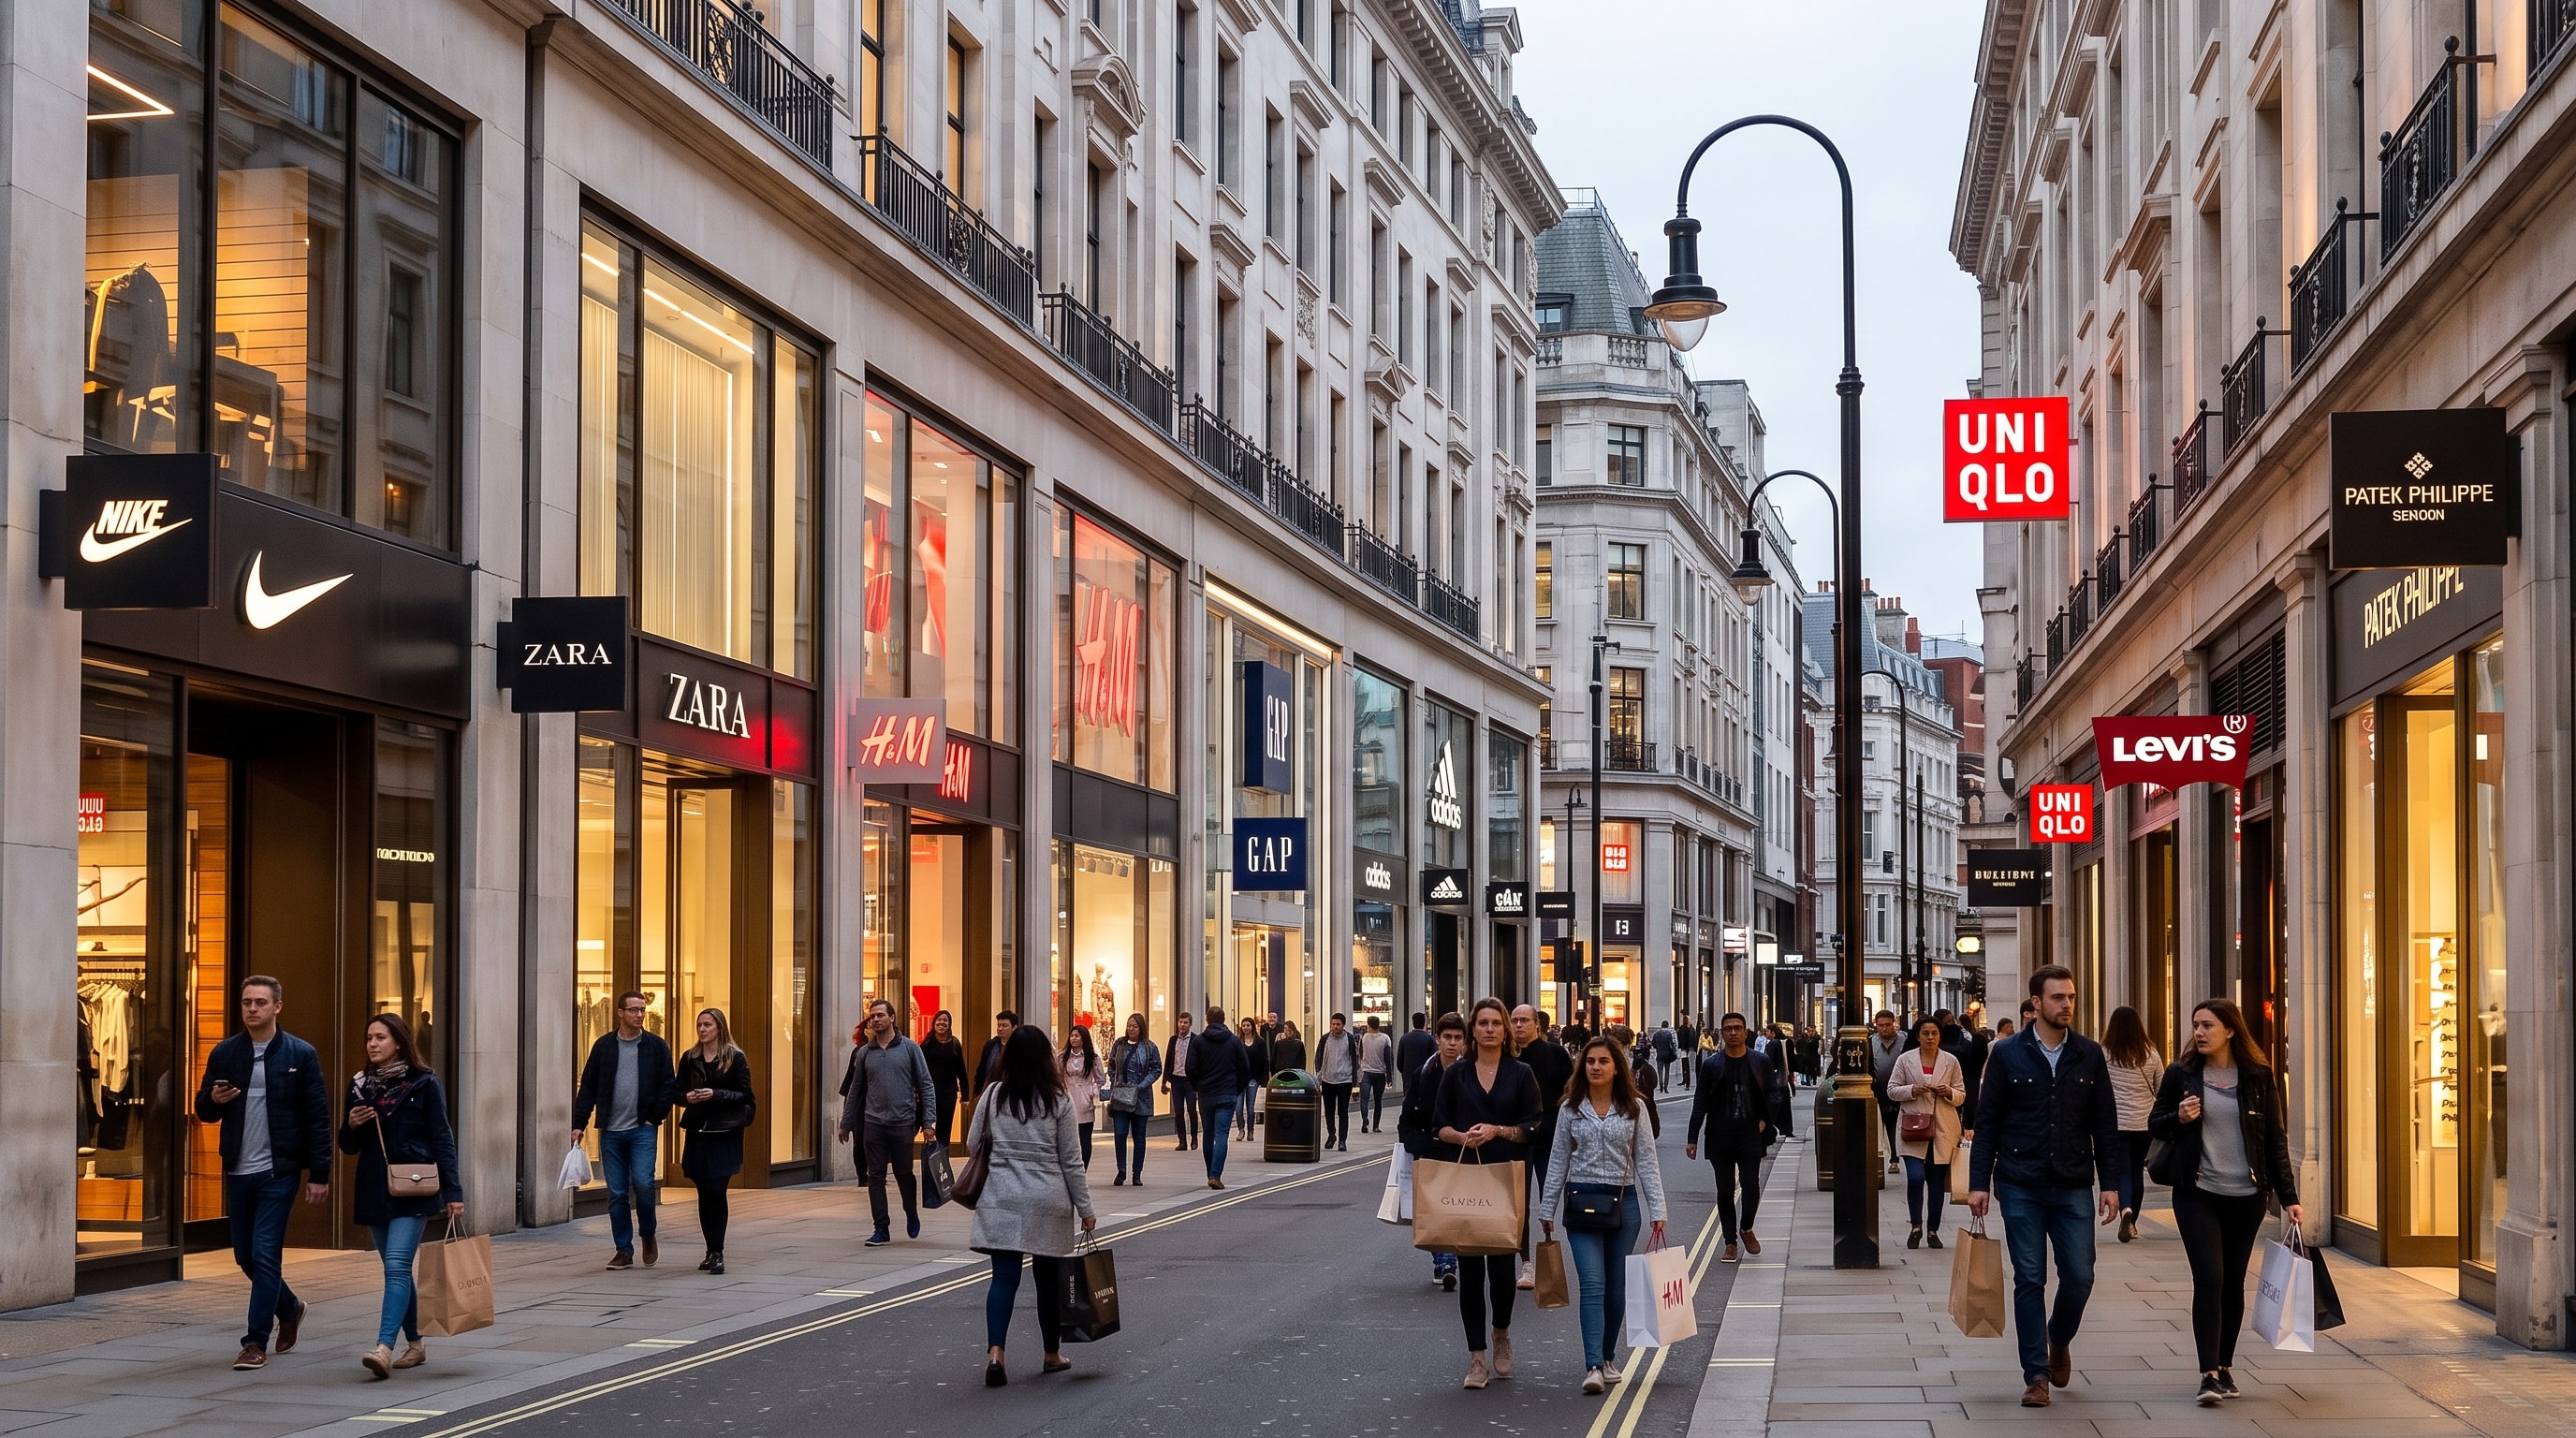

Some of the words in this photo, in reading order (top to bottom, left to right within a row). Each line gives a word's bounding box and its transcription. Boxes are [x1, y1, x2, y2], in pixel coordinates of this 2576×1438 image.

[1959, 412, 2045, 454] UNI
[1959, 462, 2055, 511] QLO
[2345, 486, 2403, 506] PATEK
[2408, 484, 2494, 504] PHILIPPE
[95, 499, 168, 535] NIKE
[2364, 581, 2402, 649] PATEK
[523, 643, 612, 666] ZARA
[668, 672, 751, 739] ZARA
[860, 714, 937, 768] H&M
[1266, 695, 1289, 762] GAP
[942, 741, 972, 803] H&M
[1431, 795, 1462, 830] adidas
[2038, 792, 2081, 813] UNI
[2039, 814, 2086, 839] QLO
[1248, 836, 1293, 873] GAP
